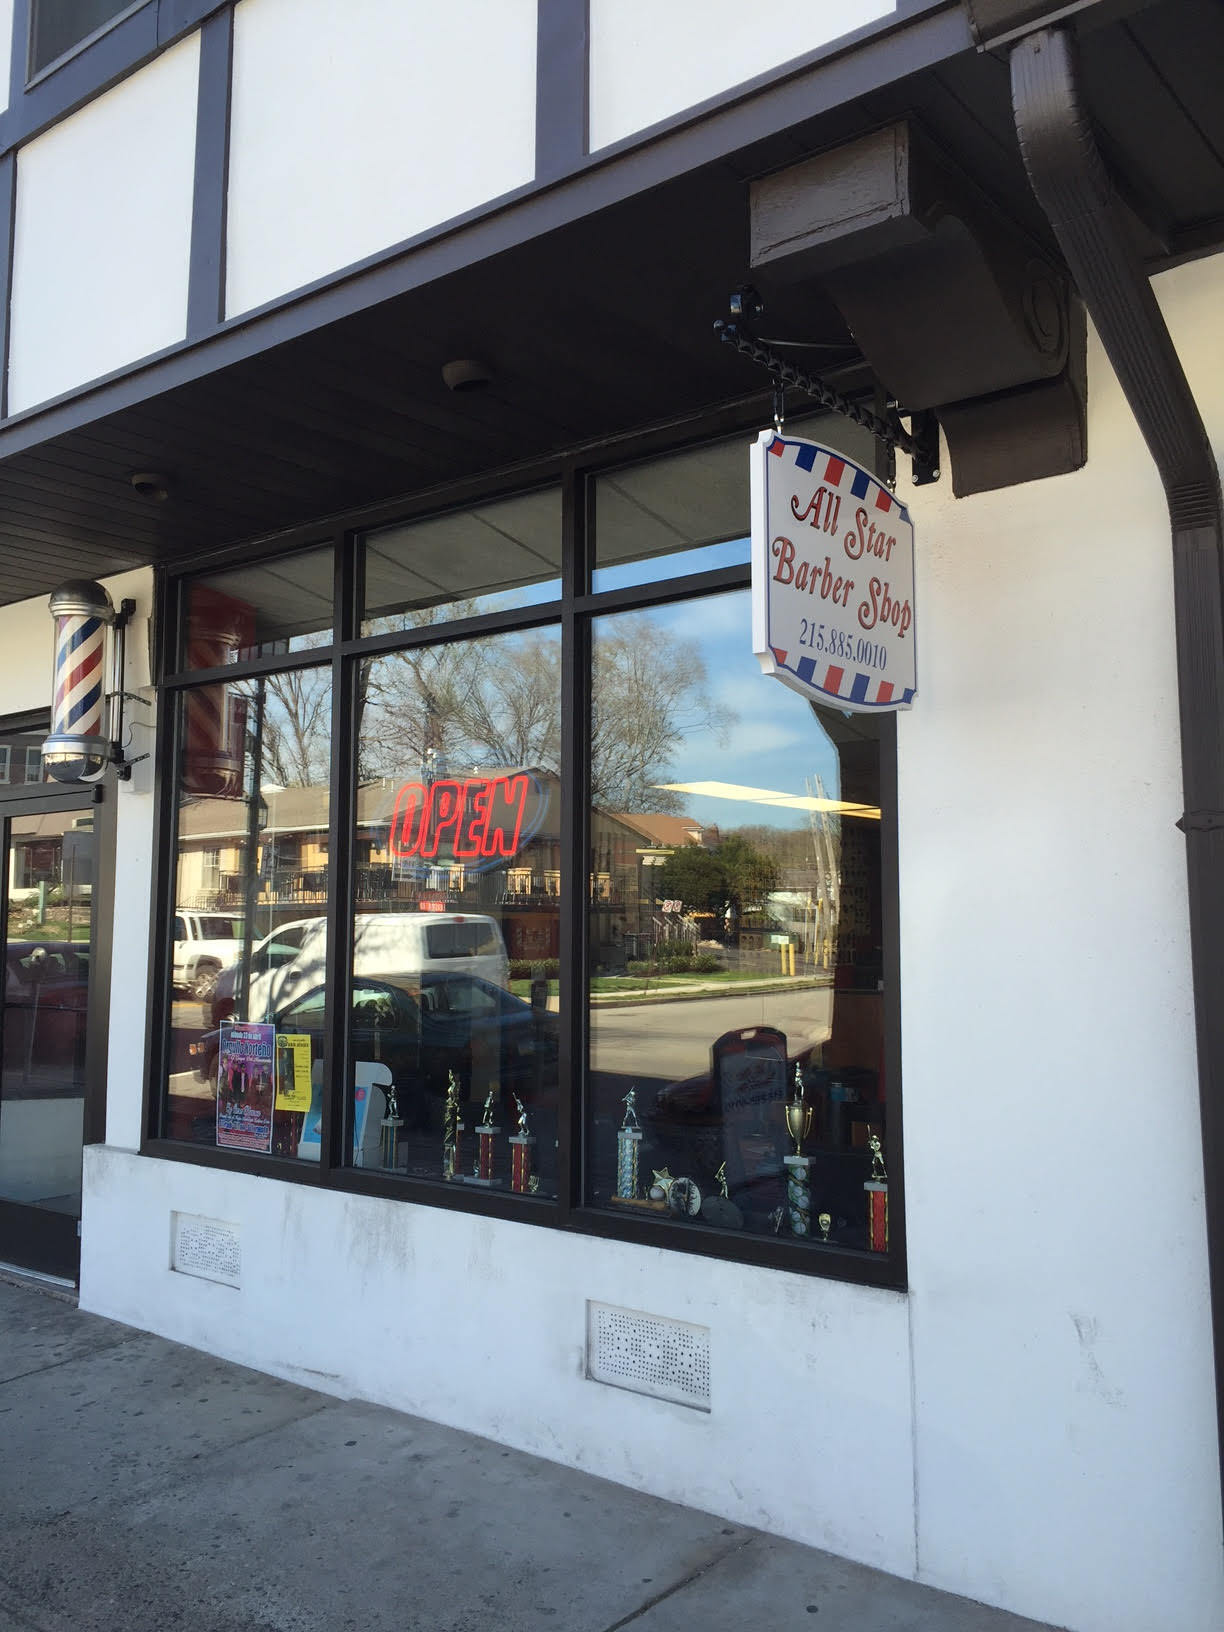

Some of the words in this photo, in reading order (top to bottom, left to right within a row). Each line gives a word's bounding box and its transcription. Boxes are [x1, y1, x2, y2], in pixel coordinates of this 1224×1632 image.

[791, 487, 841, 536] All
[844, 507, 896, 561] Star
[772, 536, 854, 608] Barber
[858, 577, 912, 638] Shop
[800, 618, 887, 671] 215.885.0010
[389, 774, 529, 857] OPEN
